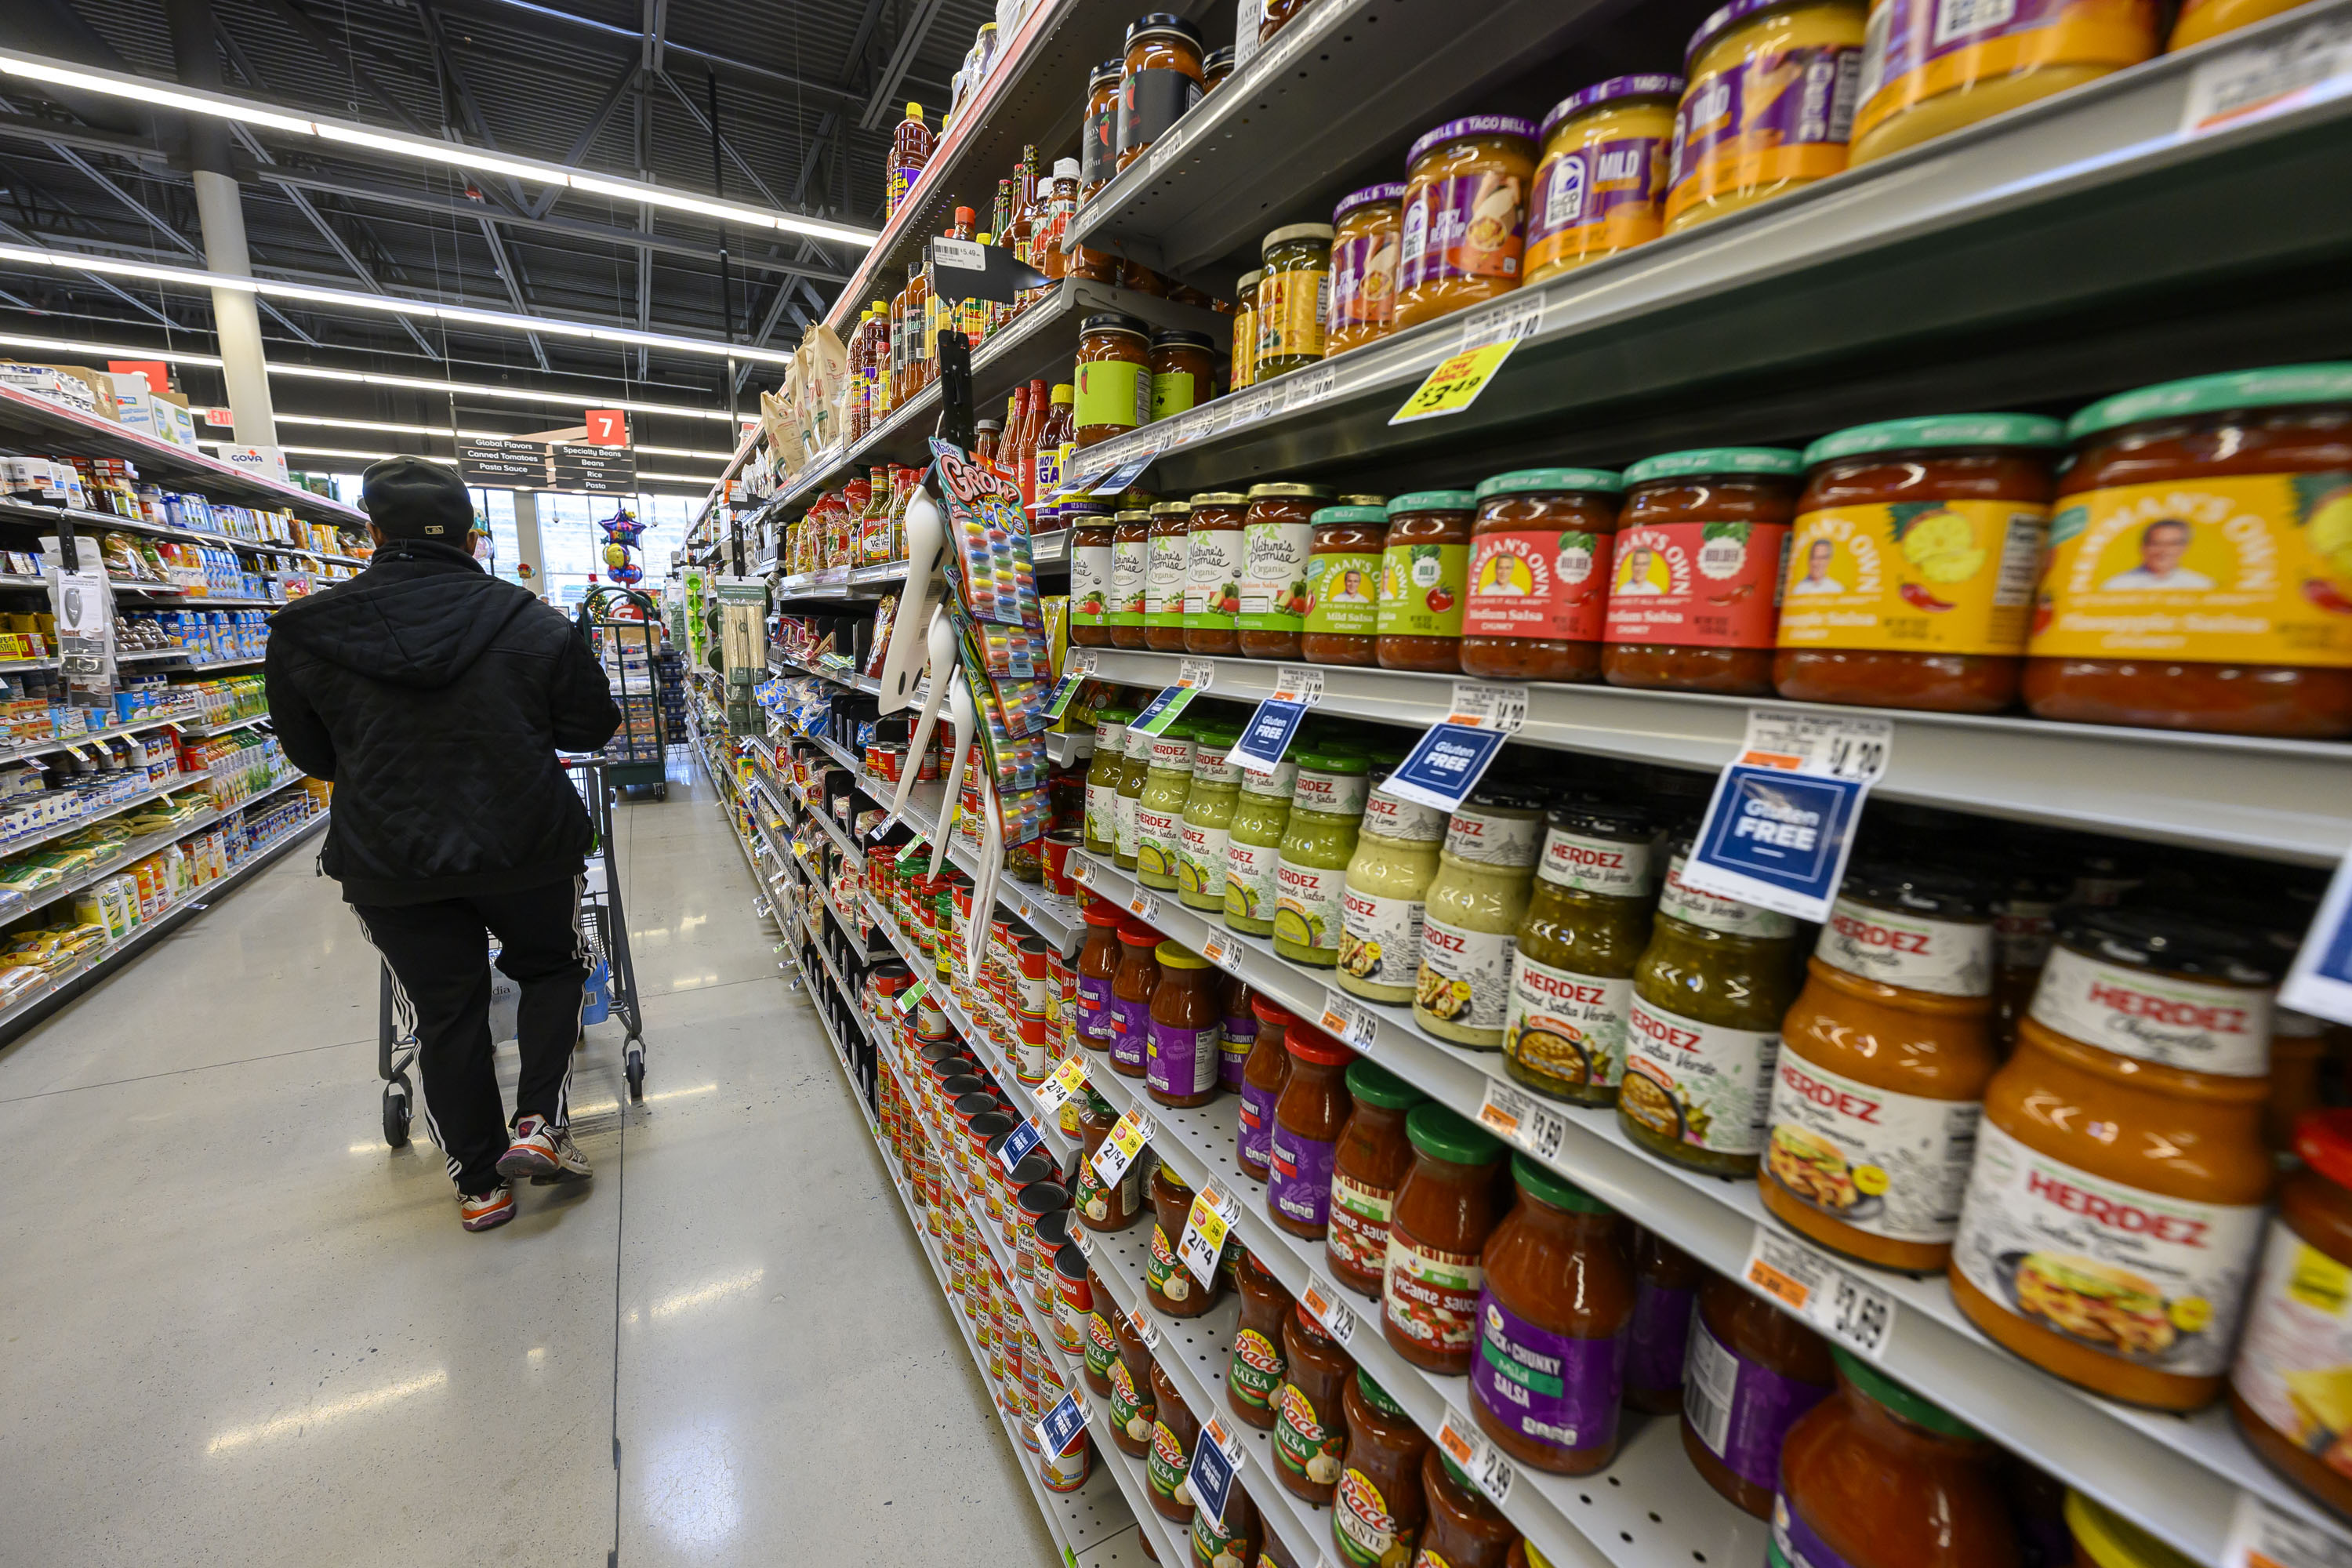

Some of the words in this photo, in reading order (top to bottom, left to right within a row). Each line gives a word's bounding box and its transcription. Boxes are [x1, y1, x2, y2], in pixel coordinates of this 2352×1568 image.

[1468, 117, 1500, 131] TACO
[1500, 118, 1526, 133] BELL
[1596, 149, 1640, 183] MILD
[892, 177, 909, 189] EGA
[598, 417, 613, 437] 7
[475, 438, 503, 448] Global
[505, 441, 532, 450] Flavors
[563, 446, 598, 457] Specialty
[598, 448, 622, 458] Beans
[931, 440, 959, 458] Magic
[231, 453, 263, 463] GOYA
[467, 450, 499, 460] Canned
[500, 452, 538, 463] Tomatoes
[581, 459, 604, 467] Beans
[479, 463, 502, 471] Pasta
[503, 464, 528, 473] Sauce
[1040, 466, 1059, 484] GA
[1189, 540, 1225, 559] Nature's
[1251, 535, 1295, 554] Nature's
[1149, 546, 1183, 562] Nature's
[1249, 551, 1301, 569] Promise
[1113, 564, 1144, 574] romise
[1149, 560, 1187, 575] Promise
[1188, 557, 1231, 573] Promise
[1253, 564, 1287, 575] Organic
[1468, 537, 1532, 597] NEWMAN'S
[1529, 552, 1551, 597] OWN
[1668, 546, 1692, 596] OWN
[1848, 535, 1883, 594] OWN
[1151, 572, 1175, 580] Organic
[1191, 568, 1218, 579] Organic
[1319, 557, 1373, 603] NEWMAN'S
[1394, 565, 1410, 600] OWN
[1326, 612, 1347, 622] Mild
[1348, 612, 1374, 622] Salsa
[1508, 609, 1544, 622] Salsa
[1643, 611, 1683, 625] Salsa
[1261, 715, 1287, 728] Gluten
[1254, 724, 1284, 740] FREE
[1152, 744, 1188, 757] HERDEZ
[1434, 741, 1476, 758] Gluten
[1172, 755, 1191, 765] Salsa
[1423, 752, 1471, 772] FREE
[1210, 764, 1229, 775] Salsa
[1315, 792, 1338, 804] Salsa
[1367, 796, 1399, 817] RDEZ
[1375, 813, 1397, 827] Lime
[1744, 798, 1820, 829] Gluten
[1157, 828, 1178, 840] Salsa
[1459, 834, 1483, 848] Lime
[1733, 816, 1818, 852] FREE
[1192, 841, 1210, 855] Salsa
[1550, 841, 1624, 869] HERDEZ
[1239, 863, 1259, 877] Salsa
[1570, 862, 1601, 881] Salsa
[1602, 867, 1632, 884] Verde
[1300, 887, 1326, 903] Salsa
[1345, 893, 1377, 917] RDEZ
[1677, 895, 1707, 913] Salsa
[1829, 902, 1932, 956] HERDEZ
[1018, 982, 1032, 990] auce
[1523, 967, 1606, 1007] HERDEZ
[1082, 990, 1099, 1001] CHUNKY
[1078, 1008, 1089, 1018] SALSA
[1546, 996, 1581, 1020] Salsa
[1582, 1004, 1618, 1024] Verde
[2088, 981, 2251, 1036] HERDEZ
[1232, 1033, 1255, 1044] CHUNKY
[1017, 1046, 1029, 1056] auce
[1224, 1053, 1242, 1064] SALSA
[1778, 1063, 1882, 1125] HERDEZ
[1012, 1136, 1024, 1152] FREE
[1103, 1142, 1127, 1172] 2/$4
[1352, 1201, 1369, 1214] MILD
[2025, 1169, 2216, 1250] HERDEZ
[1361, 1222, 1389, 1244] sauc
[1187, 1228, 1212, 1267] 2/$4
[1034, 1275, 1047, 1287] eans
[1432, 1272, 1452, 1286] MILD
[1054, 1308, 1066, 1323] eans
[1234, 1332, 1283, 1374] Pace
[1511, 1342, 1562, 1377] CHUNKY
[1233, 1363, 1269, 1390] SALSA
[1493, 1371, 1530, 1410] SALSA
[1060, 1409, 1072, 1430] Gluten
[1280, 1386, 1325, 1442] Pace
[1054, 1414, 1069, 1438] FREE
[1277, 1418, 1308, 1457] SALSA
[1152, 1423, 1189, 1470] Pace
[1203, 1453, 1222, 1483] Gluten
[1200, 1460, 1219, 1494] FREE
[1341, 1468, 1397, 1534] Pace
